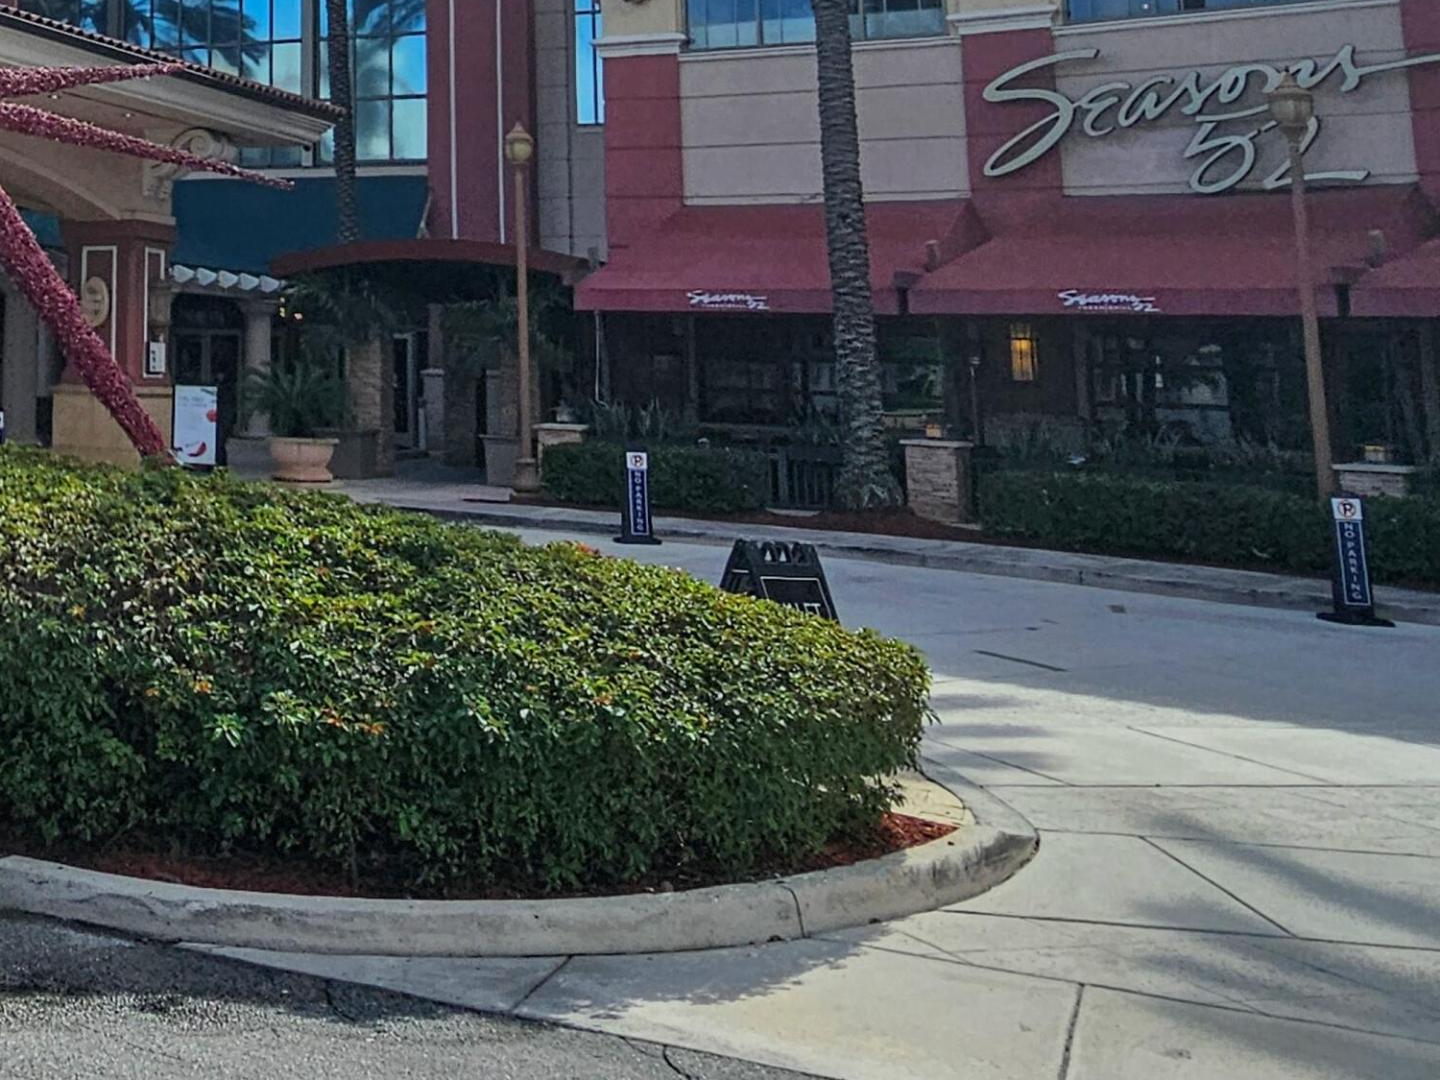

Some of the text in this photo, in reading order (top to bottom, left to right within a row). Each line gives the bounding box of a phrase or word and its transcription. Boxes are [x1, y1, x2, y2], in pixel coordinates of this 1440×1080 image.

[981, 45, 1440, 177] Seasons
[1182, 103, 1369, 194] 52
[1058, 289, 1156, 306] Seasons
[1344, 523, 1362, 599] NO PARKING
